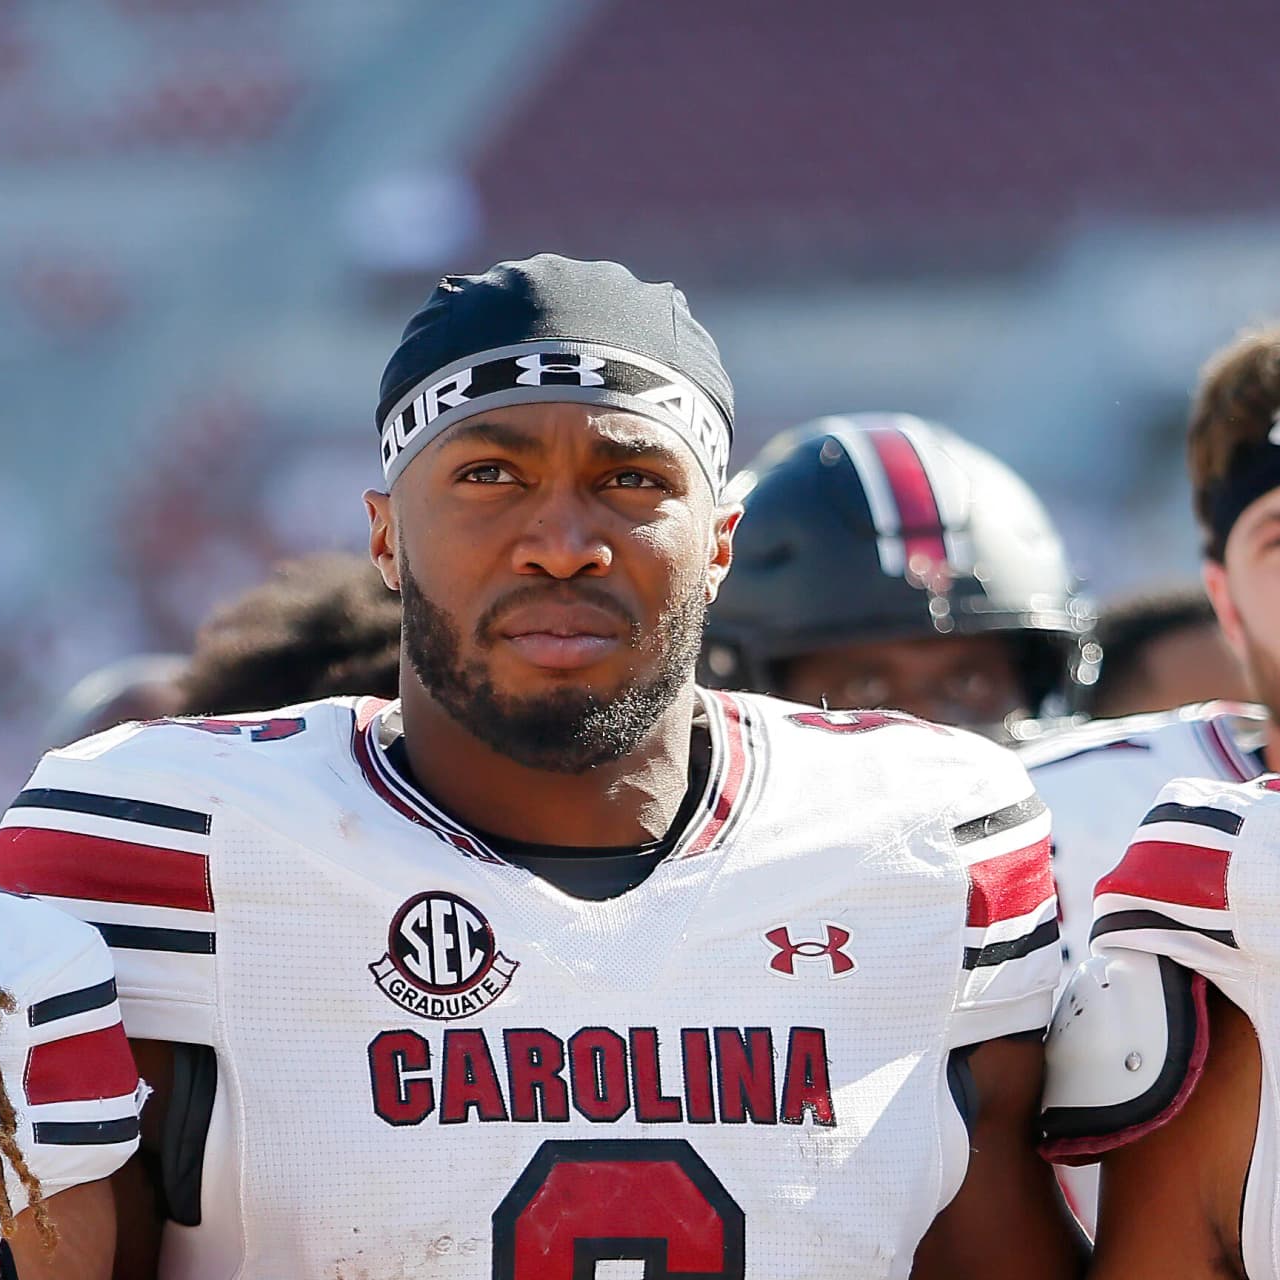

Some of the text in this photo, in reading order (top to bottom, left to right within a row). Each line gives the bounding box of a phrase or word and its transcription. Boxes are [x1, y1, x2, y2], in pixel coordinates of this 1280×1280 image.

[400, 899, 485, 985] SEC
[389, 978, 499, 1016] GRADUATE
[368, 1026, 837, 1127] CAROLINA
